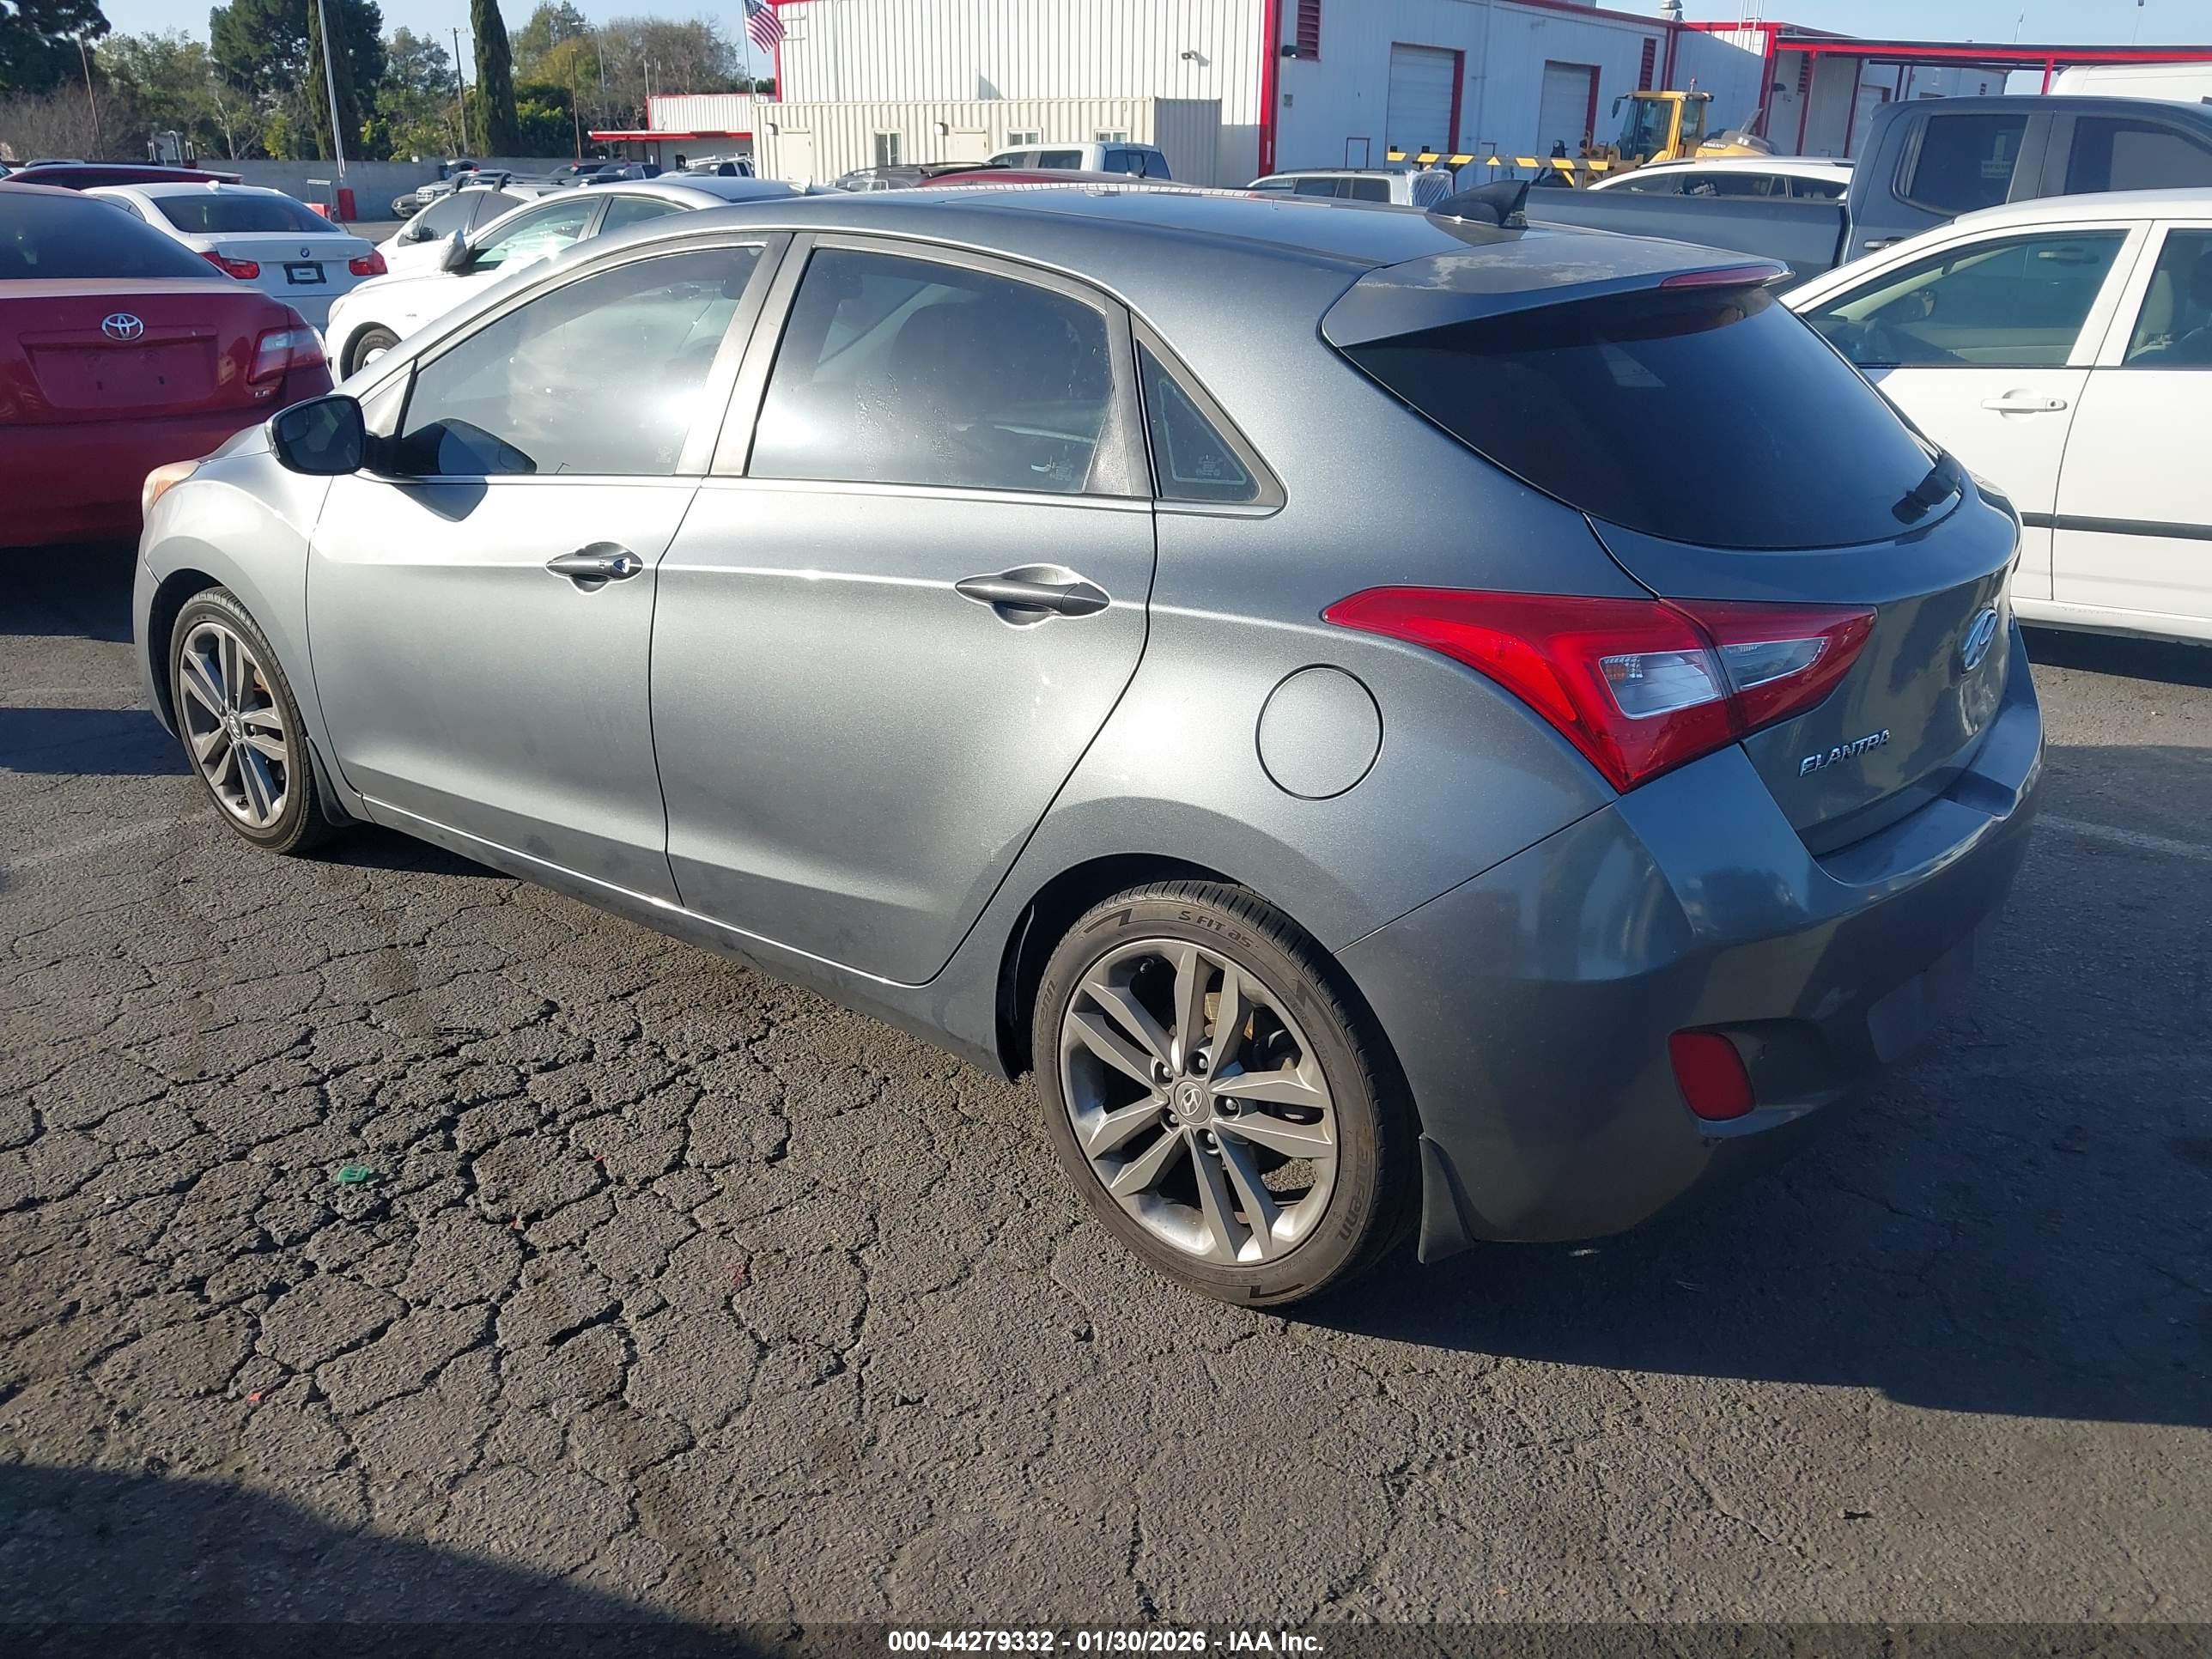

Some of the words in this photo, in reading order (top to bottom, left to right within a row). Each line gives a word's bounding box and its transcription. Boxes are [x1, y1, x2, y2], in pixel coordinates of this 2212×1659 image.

[1799, 728, 1891, 777] ELANTRA
[1178, 910, 1192, 921] S
[1196, 915, 1226, 932] FIT
